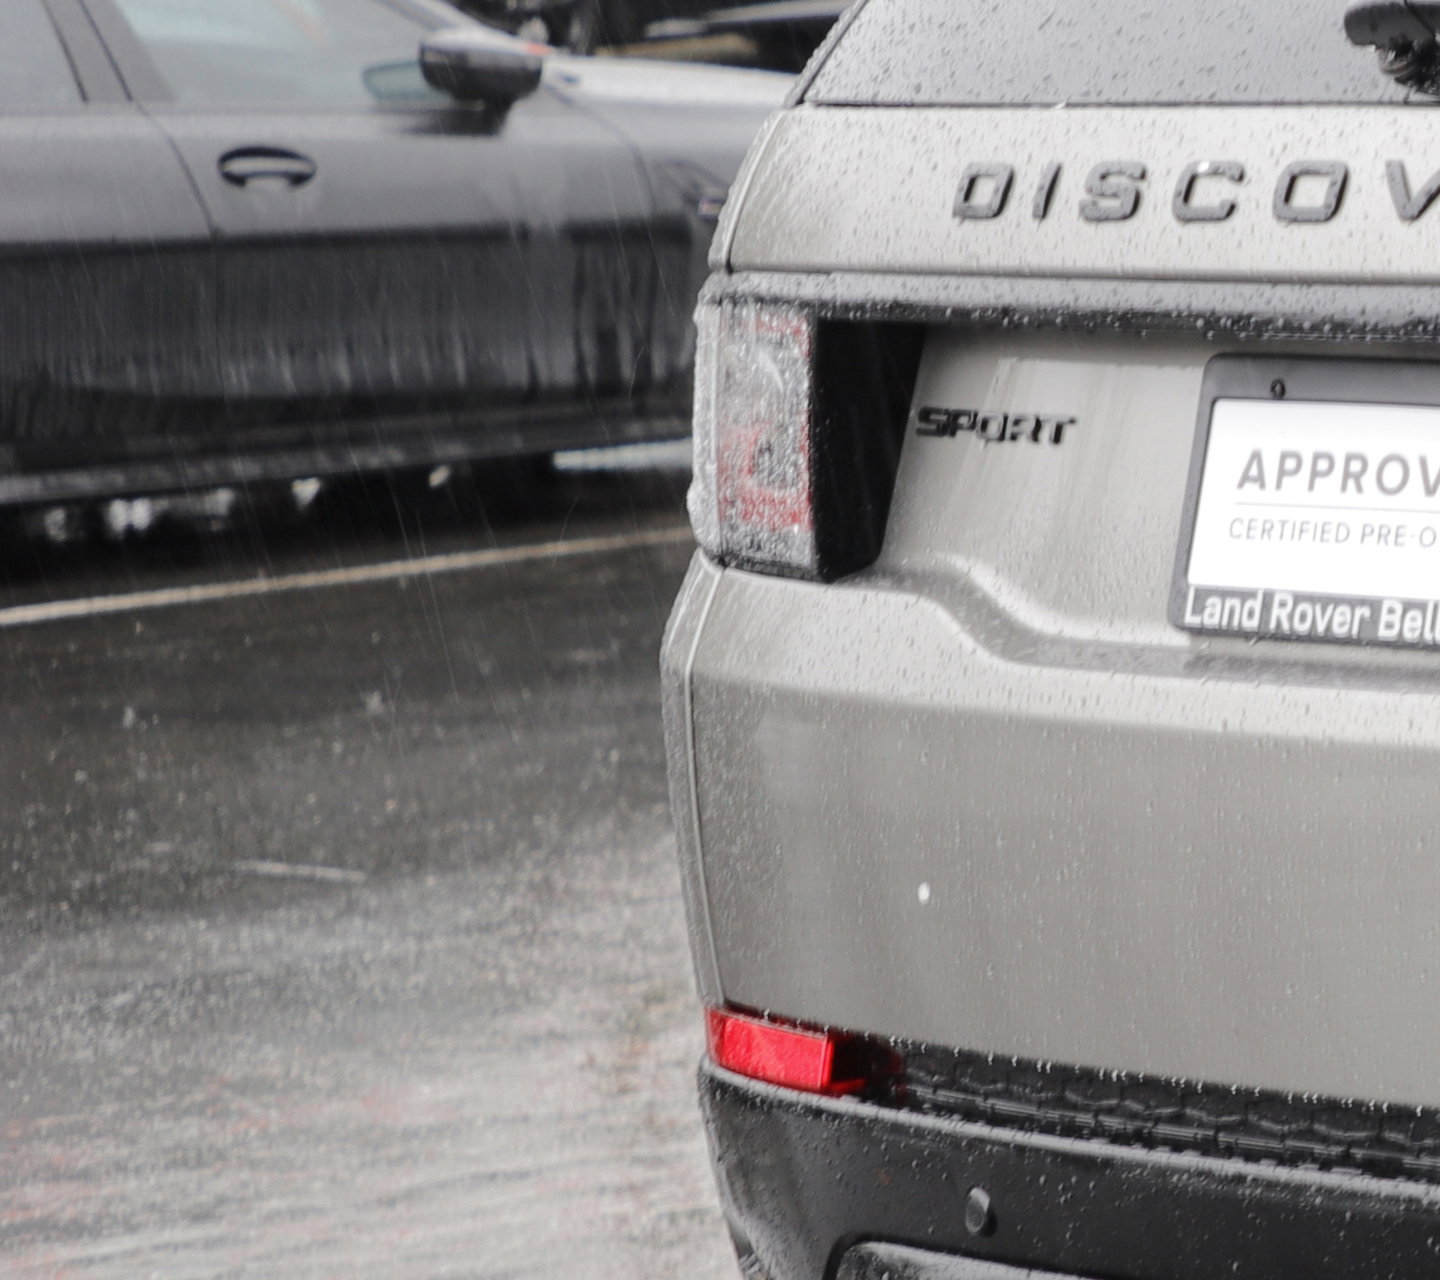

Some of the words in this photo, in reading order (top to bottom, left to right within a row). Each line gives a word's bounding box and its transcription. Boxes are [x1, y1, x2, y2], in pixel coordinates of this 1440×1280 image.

[916, 407, 1077, 444] SPORT
[1229, 517, 1350, 544] CERTIFIED
[1184, 586, 1264, 631] Land
[1269, 591, 1371, 639] Rover
